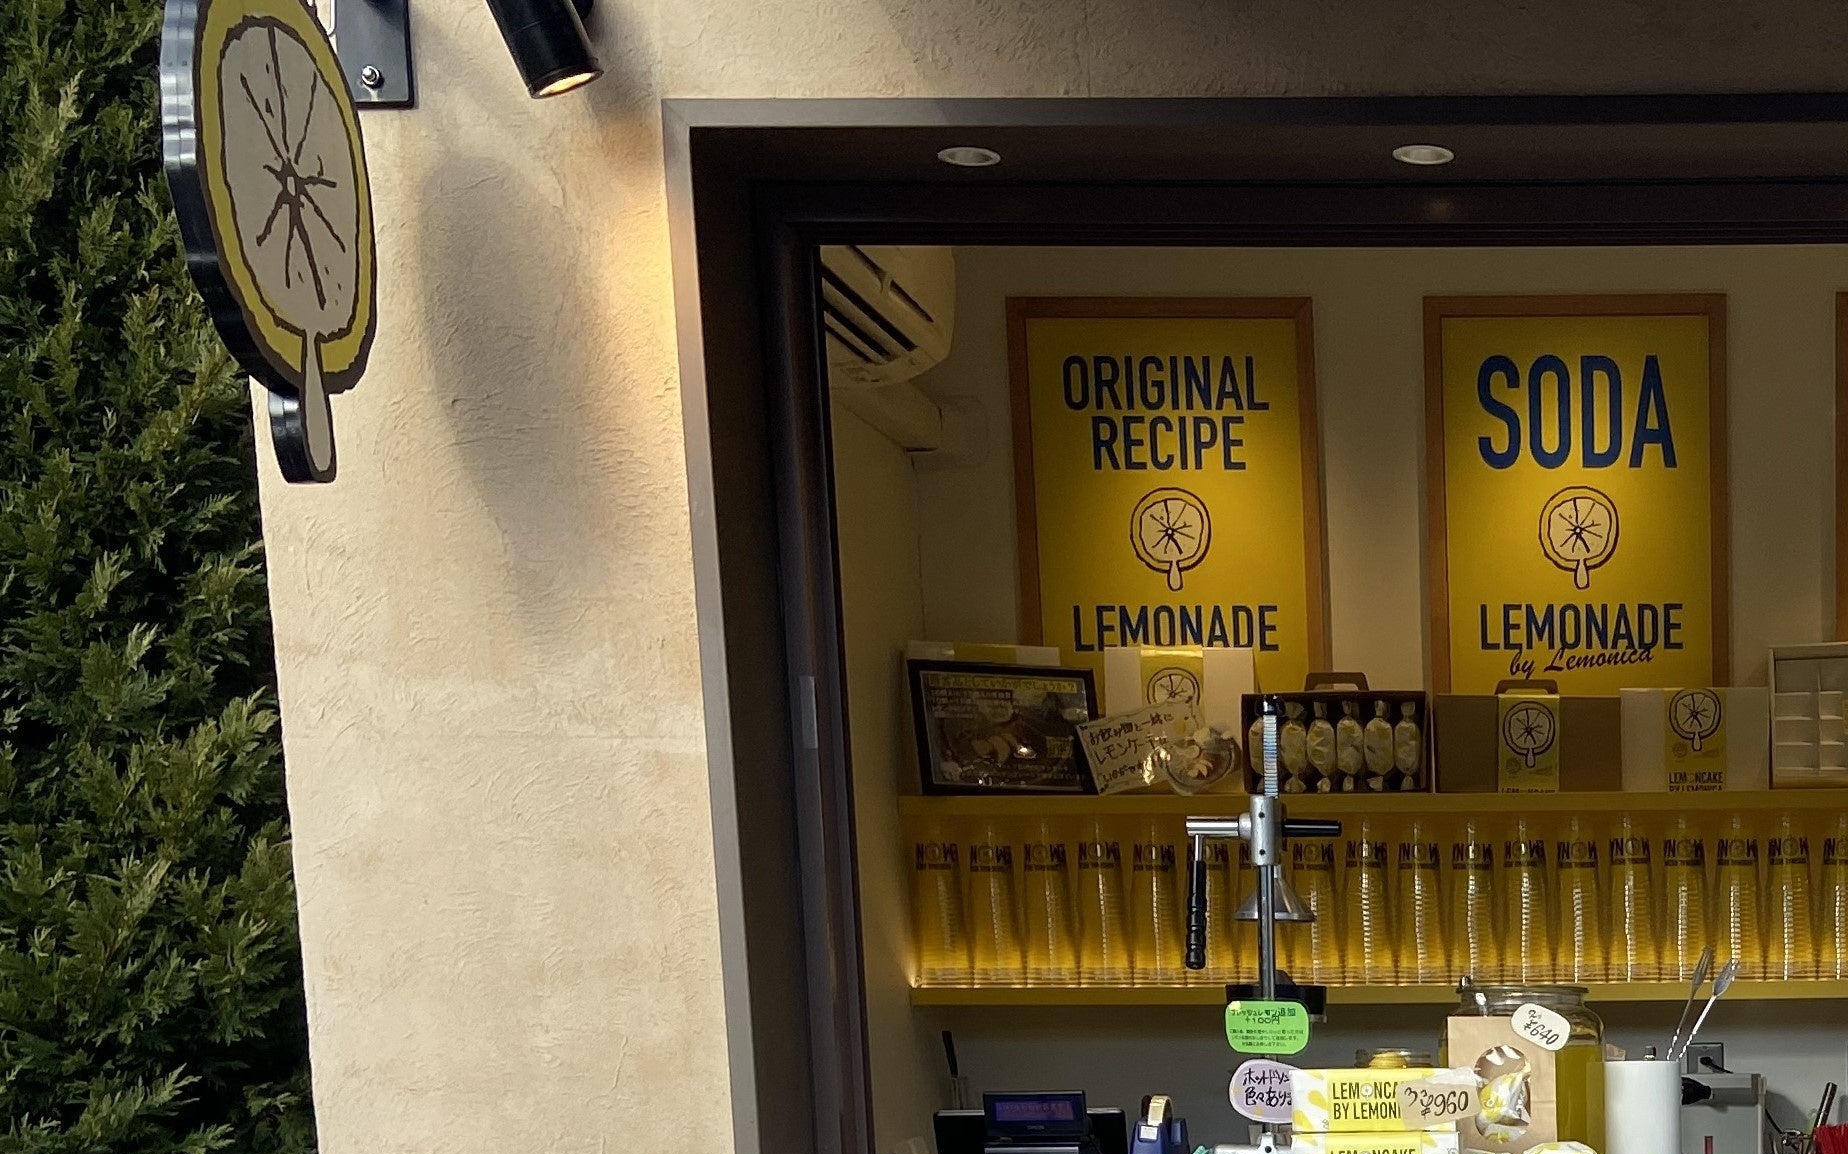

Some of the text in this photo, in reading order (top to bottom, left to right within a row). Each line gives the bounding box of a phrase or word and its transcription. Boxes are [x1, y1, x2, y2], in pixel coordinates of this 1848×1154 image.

[1062, 355, 1269, 412] ORIGINAL
[1477, 354, 1678, 470] SODA
[1092, 416, 1247, 471] RECIPE
[1073, 604, 1280, 653] LEMONADE
[1480, 602, 1684, 652] LEMONADE
[1510, 645, 1655, 679] by Lemonica
[1523, 1018, 1560, 1046] ¥640
[1333, 1103, 1350, 1120] BY
